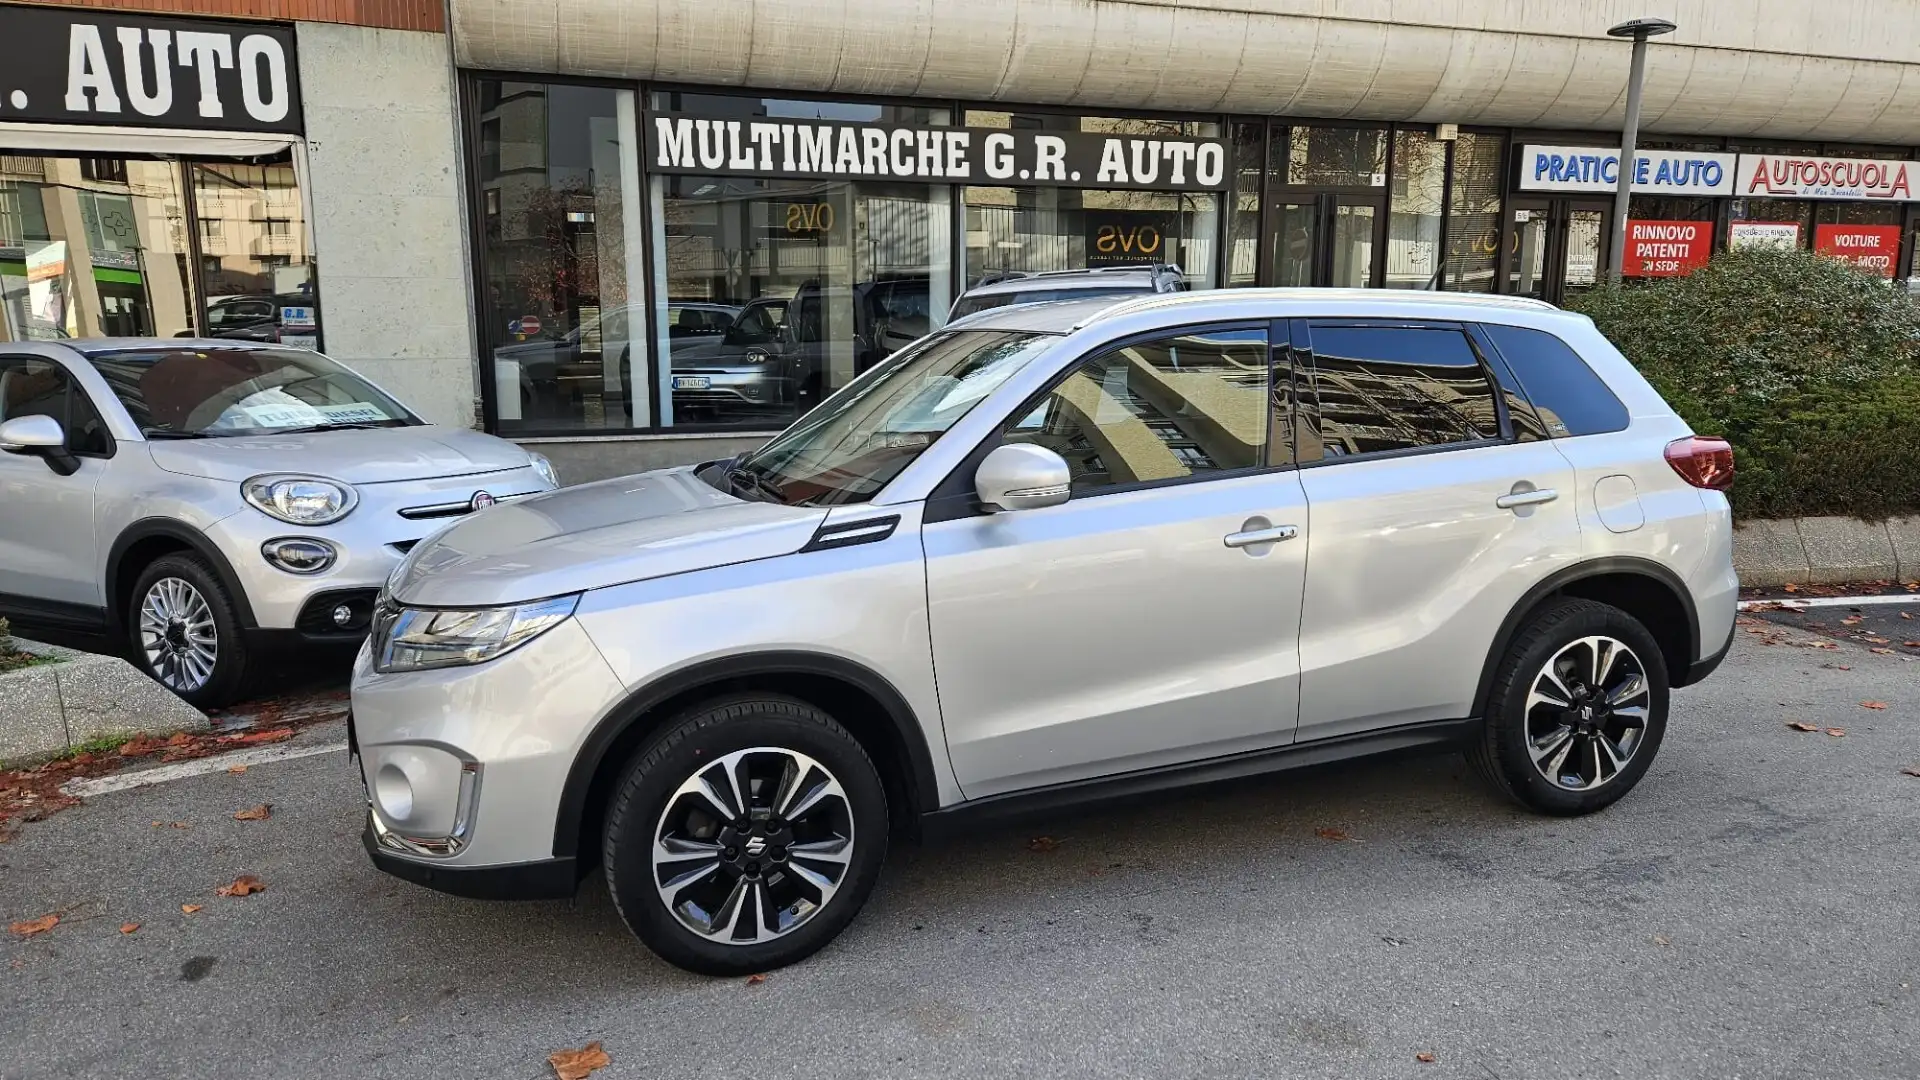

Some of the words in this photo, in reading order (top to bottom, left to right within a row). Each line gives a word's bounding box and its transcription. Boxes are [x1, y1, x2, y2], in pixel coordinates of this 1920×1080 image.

[65, 23, 289, 123] AUTO
[656, 117, 971, 178] MULTIMARCHE
[984, 132, 1081, 182] G.R.
[1096, 138, 1225, 186] AUTO
[1535, 153, 1650, 184] PRATICE
[1654, 159, 1723, 187] AUTO
[1749, 156, 1911, 198] AUTOSCUOLA
[1632, 225, 1696, 240] RINNOVO
[1834, 234, 1881, 248] VOLTURE
[1636, 243, 1690, 258] PATENTI
